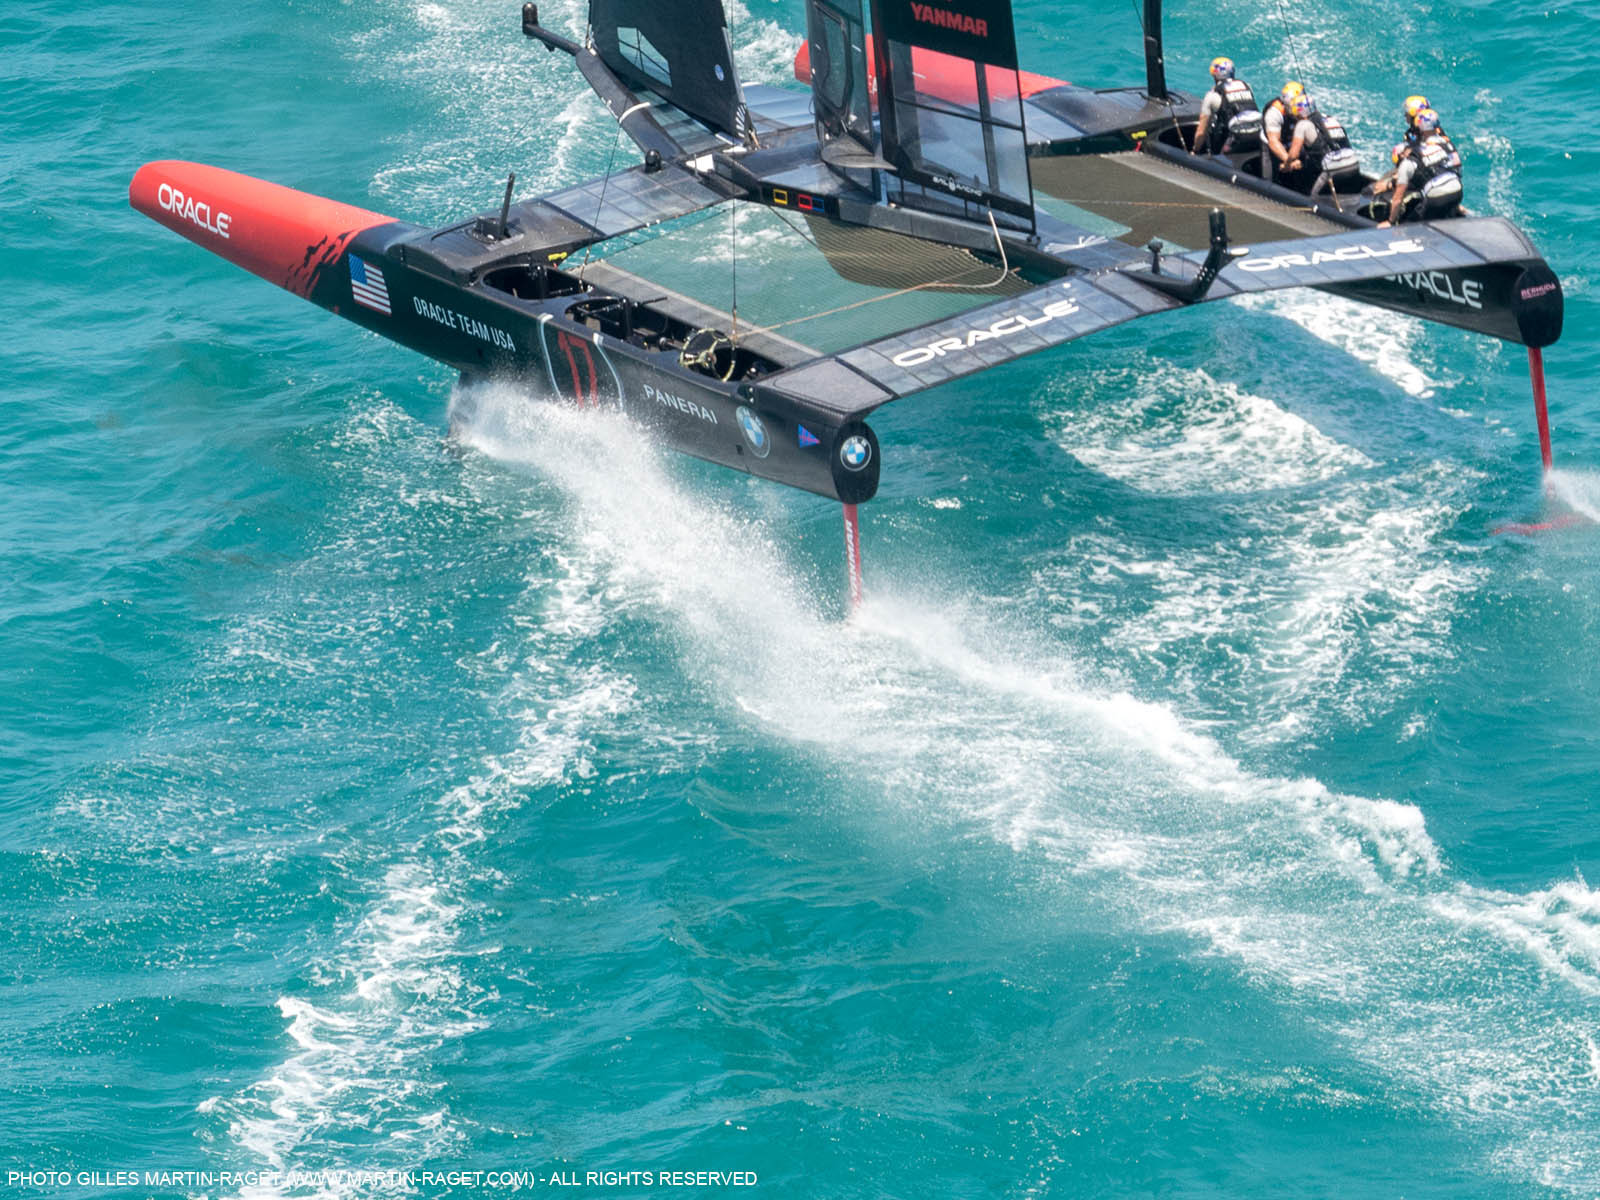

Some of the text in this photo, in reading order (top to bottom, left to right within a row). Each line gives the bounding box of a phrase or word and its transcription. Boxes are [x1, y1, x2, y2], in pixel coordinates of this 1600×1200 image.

[910, 1, 988, 37] YANMAR
[158, 183, 231, 239] ORACLE
[1238, 239, 1424, 272] ORACLE
[413, 296, 517, 352] ORACLE TEAM USA
[892, 298, 1081, 368] ORACLE
[643, 384, 718, 425] PANERAI
